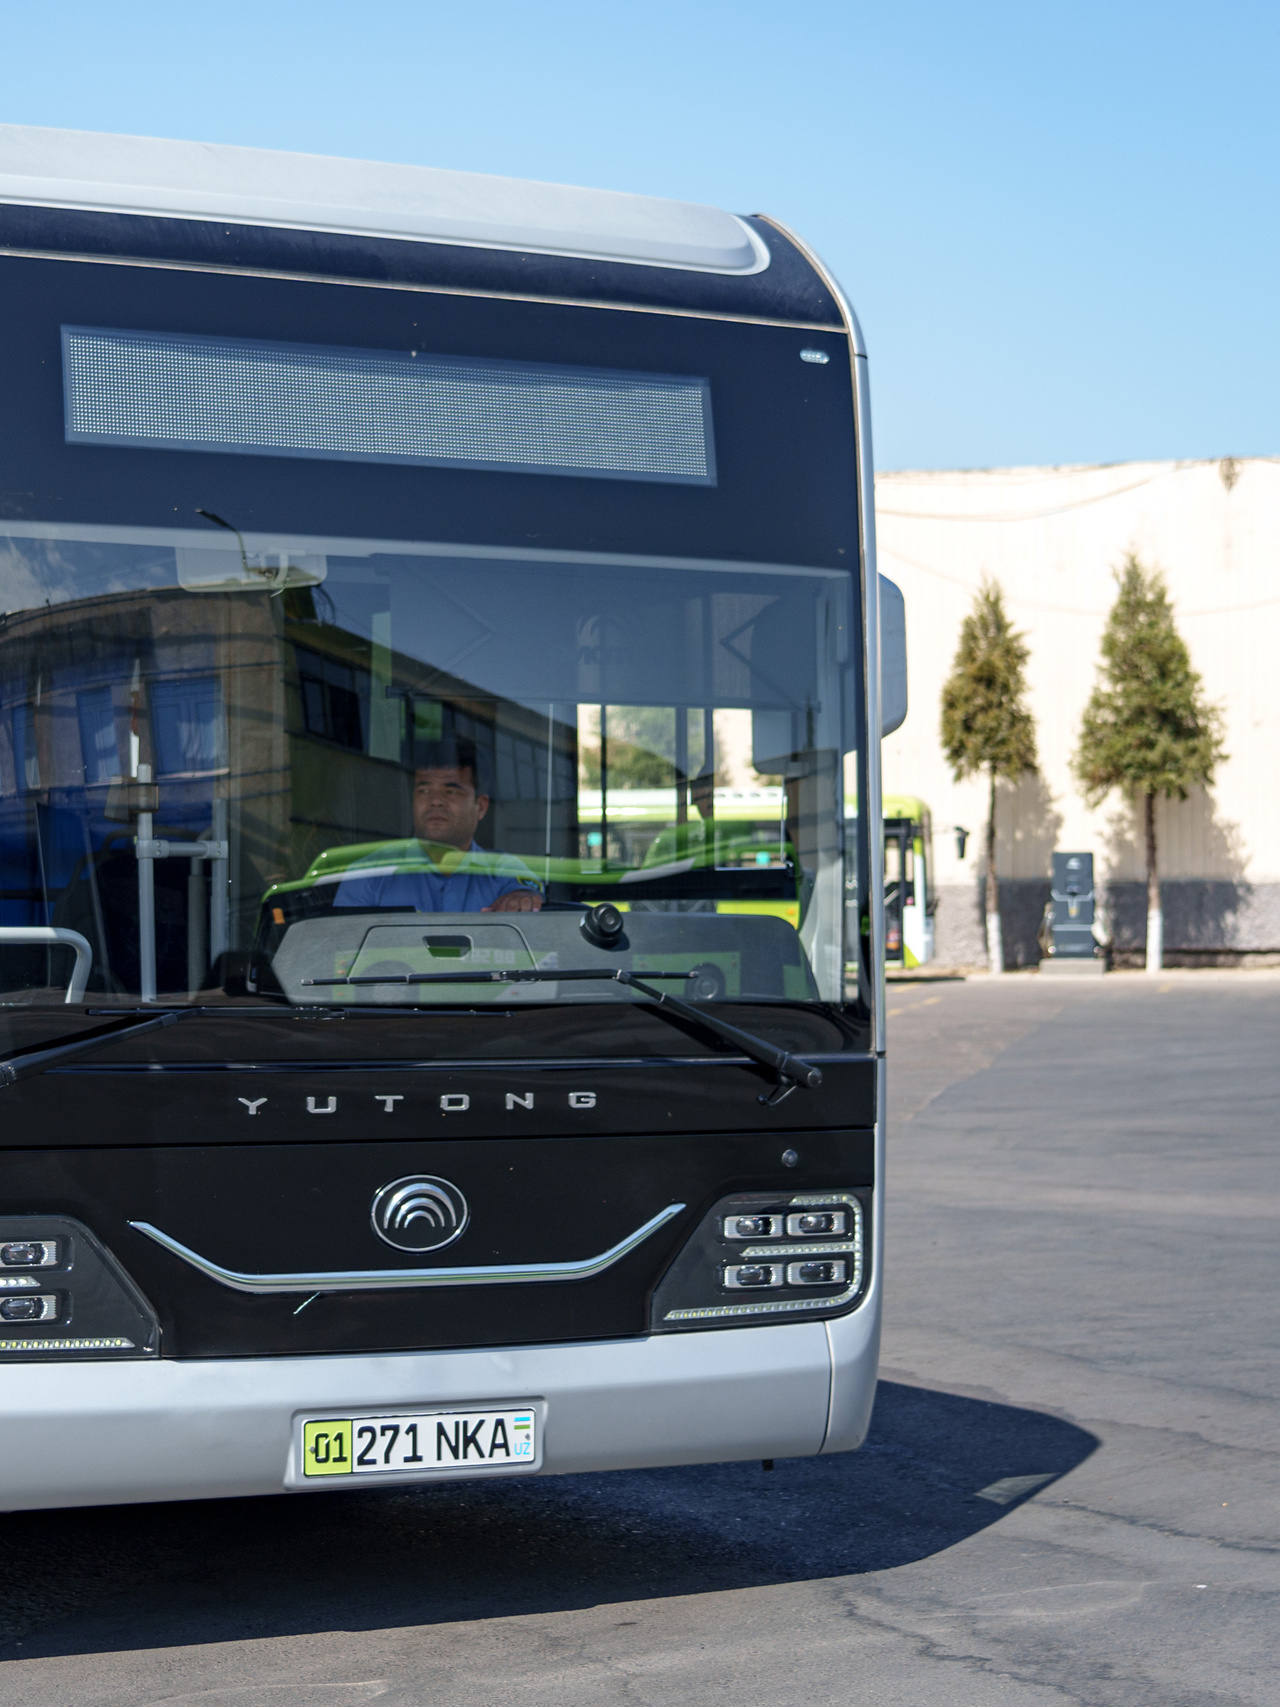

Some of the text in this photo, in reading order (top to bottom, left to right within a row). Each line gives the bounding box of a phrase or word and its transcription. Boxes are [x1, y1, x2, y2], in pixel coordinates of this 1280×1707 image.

[238, 1091, 597, 1116] YUTONG
[315, 1418, 531, 1466] 01 271 NKA UZ
